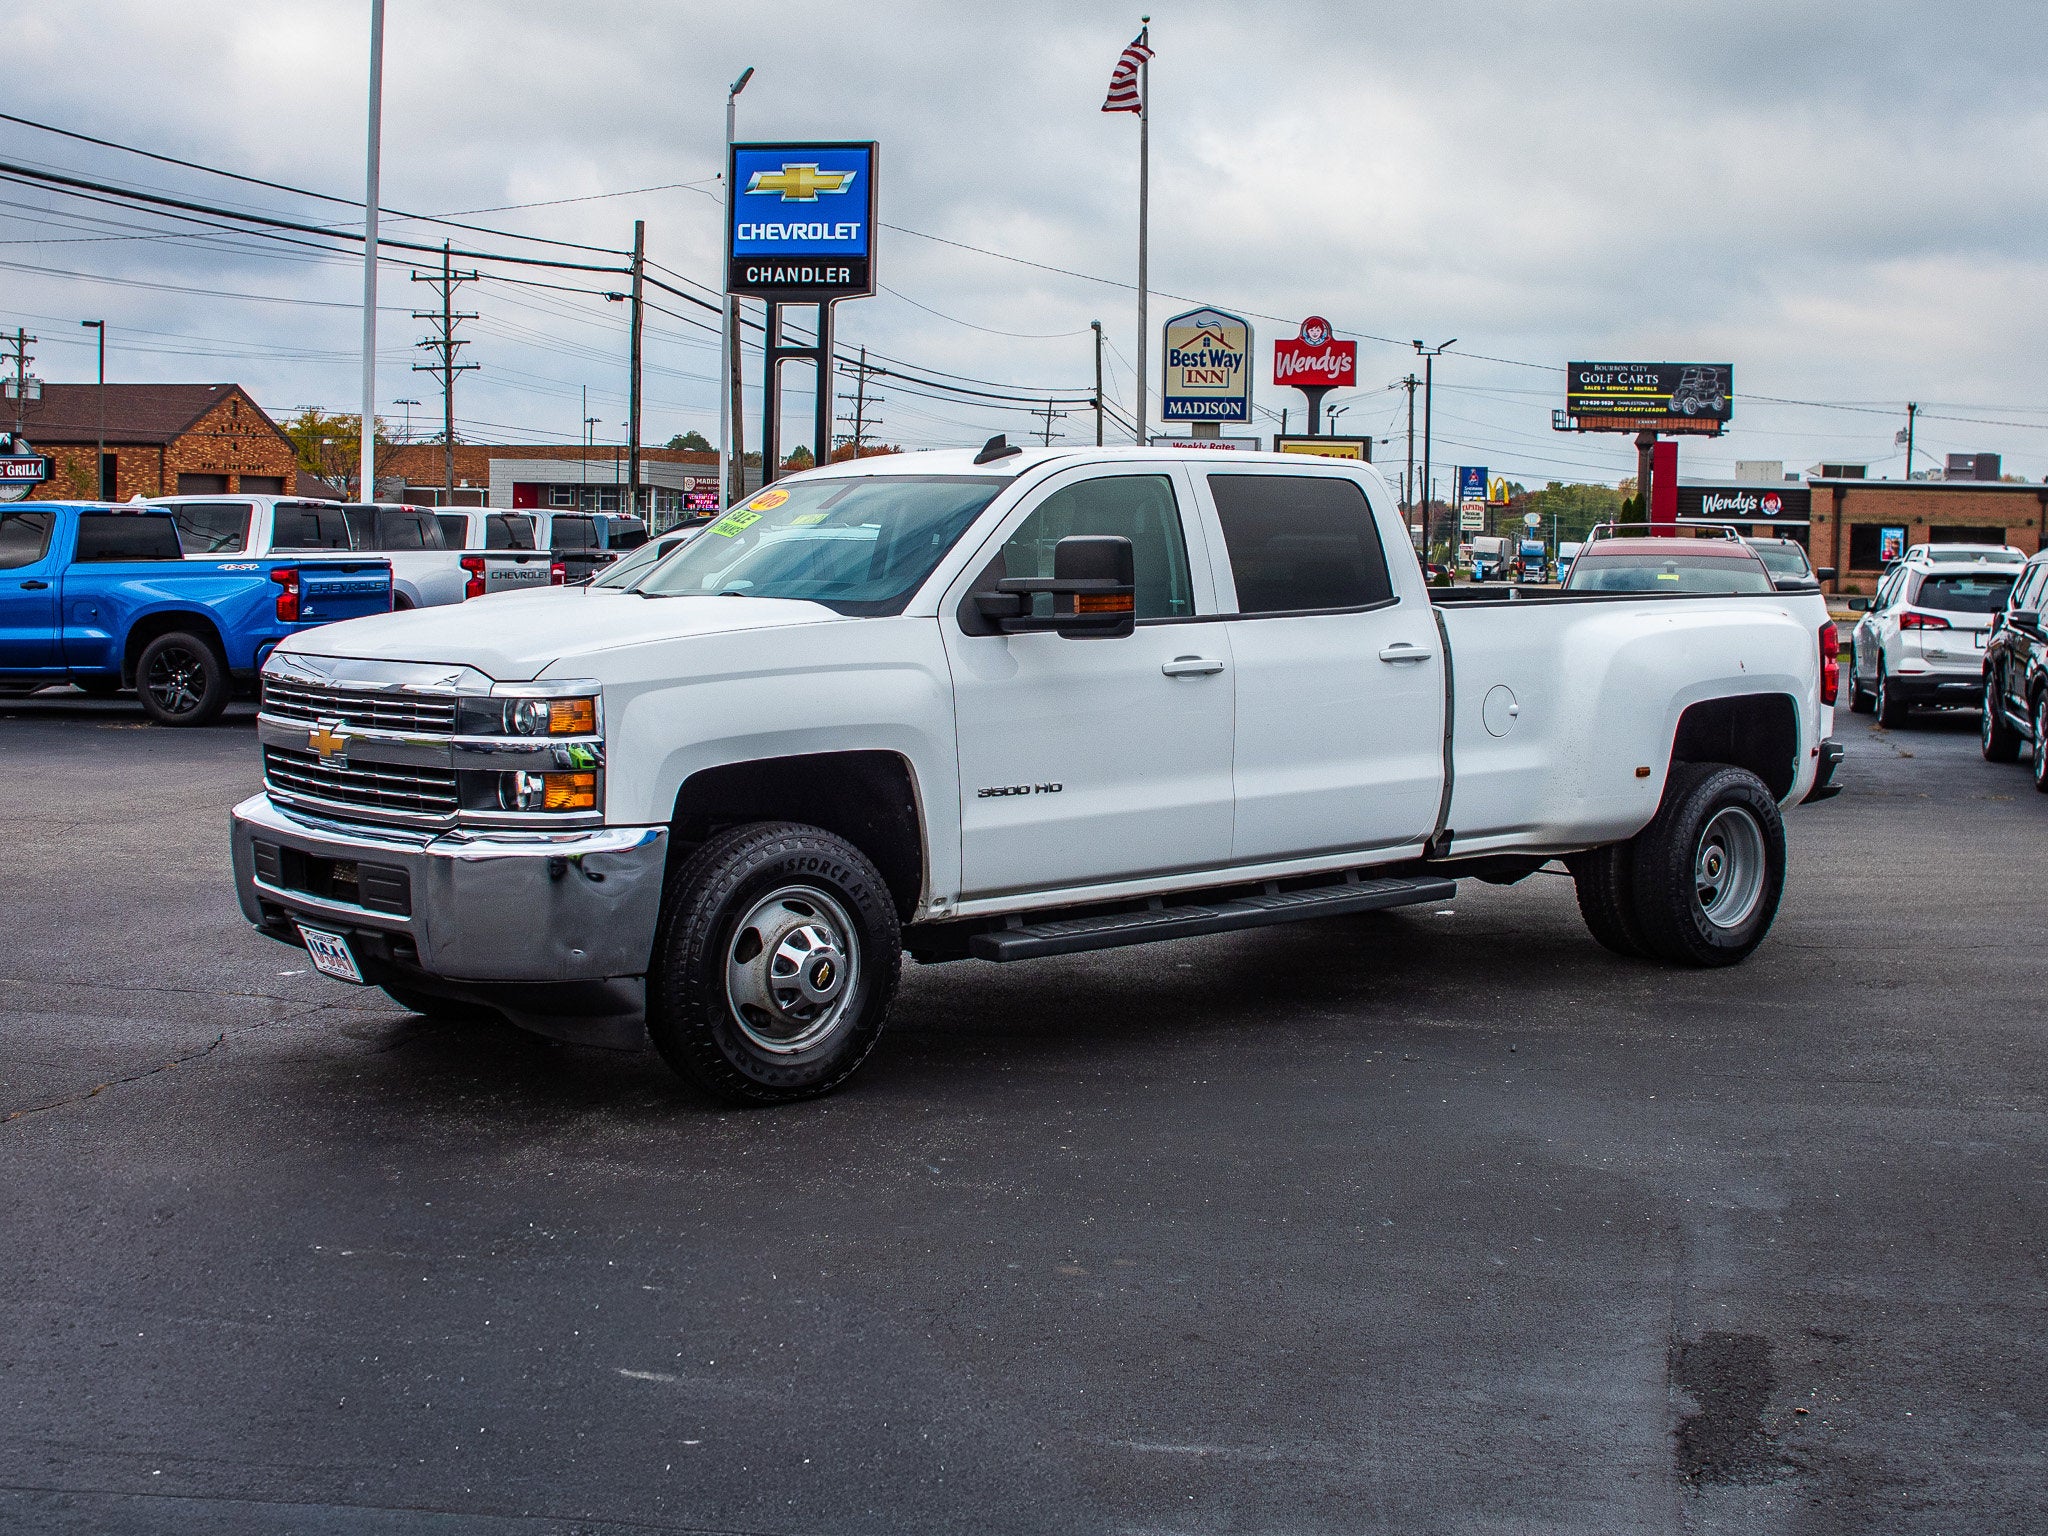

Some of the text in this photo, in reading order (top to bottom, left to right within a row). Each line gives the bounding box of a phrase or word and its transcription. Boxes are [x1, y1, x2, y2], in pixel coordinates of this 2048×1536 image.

[738, 223, 860, 240] CHEVROLET
[746, 267, 850, 283] CHANDLER
[1170, 349, 1243, 373] Best Way
[1276, 346, 1352, 379] Wendy's
[1186, 369, 1225, 384] INN
[1580, 371, 1659, 384] GOLF CARTS
[1168, 402, 1242, 415] MADISON
[6, 463, 37, 477] GRILL
[1702, 491, 1758, 515] Wendy's
[491, 569, 549, 580] CHEVROLET
[309, 581, 390, 593] CHEVROLET
[977, 782, 1063, 798] 3500 HD
